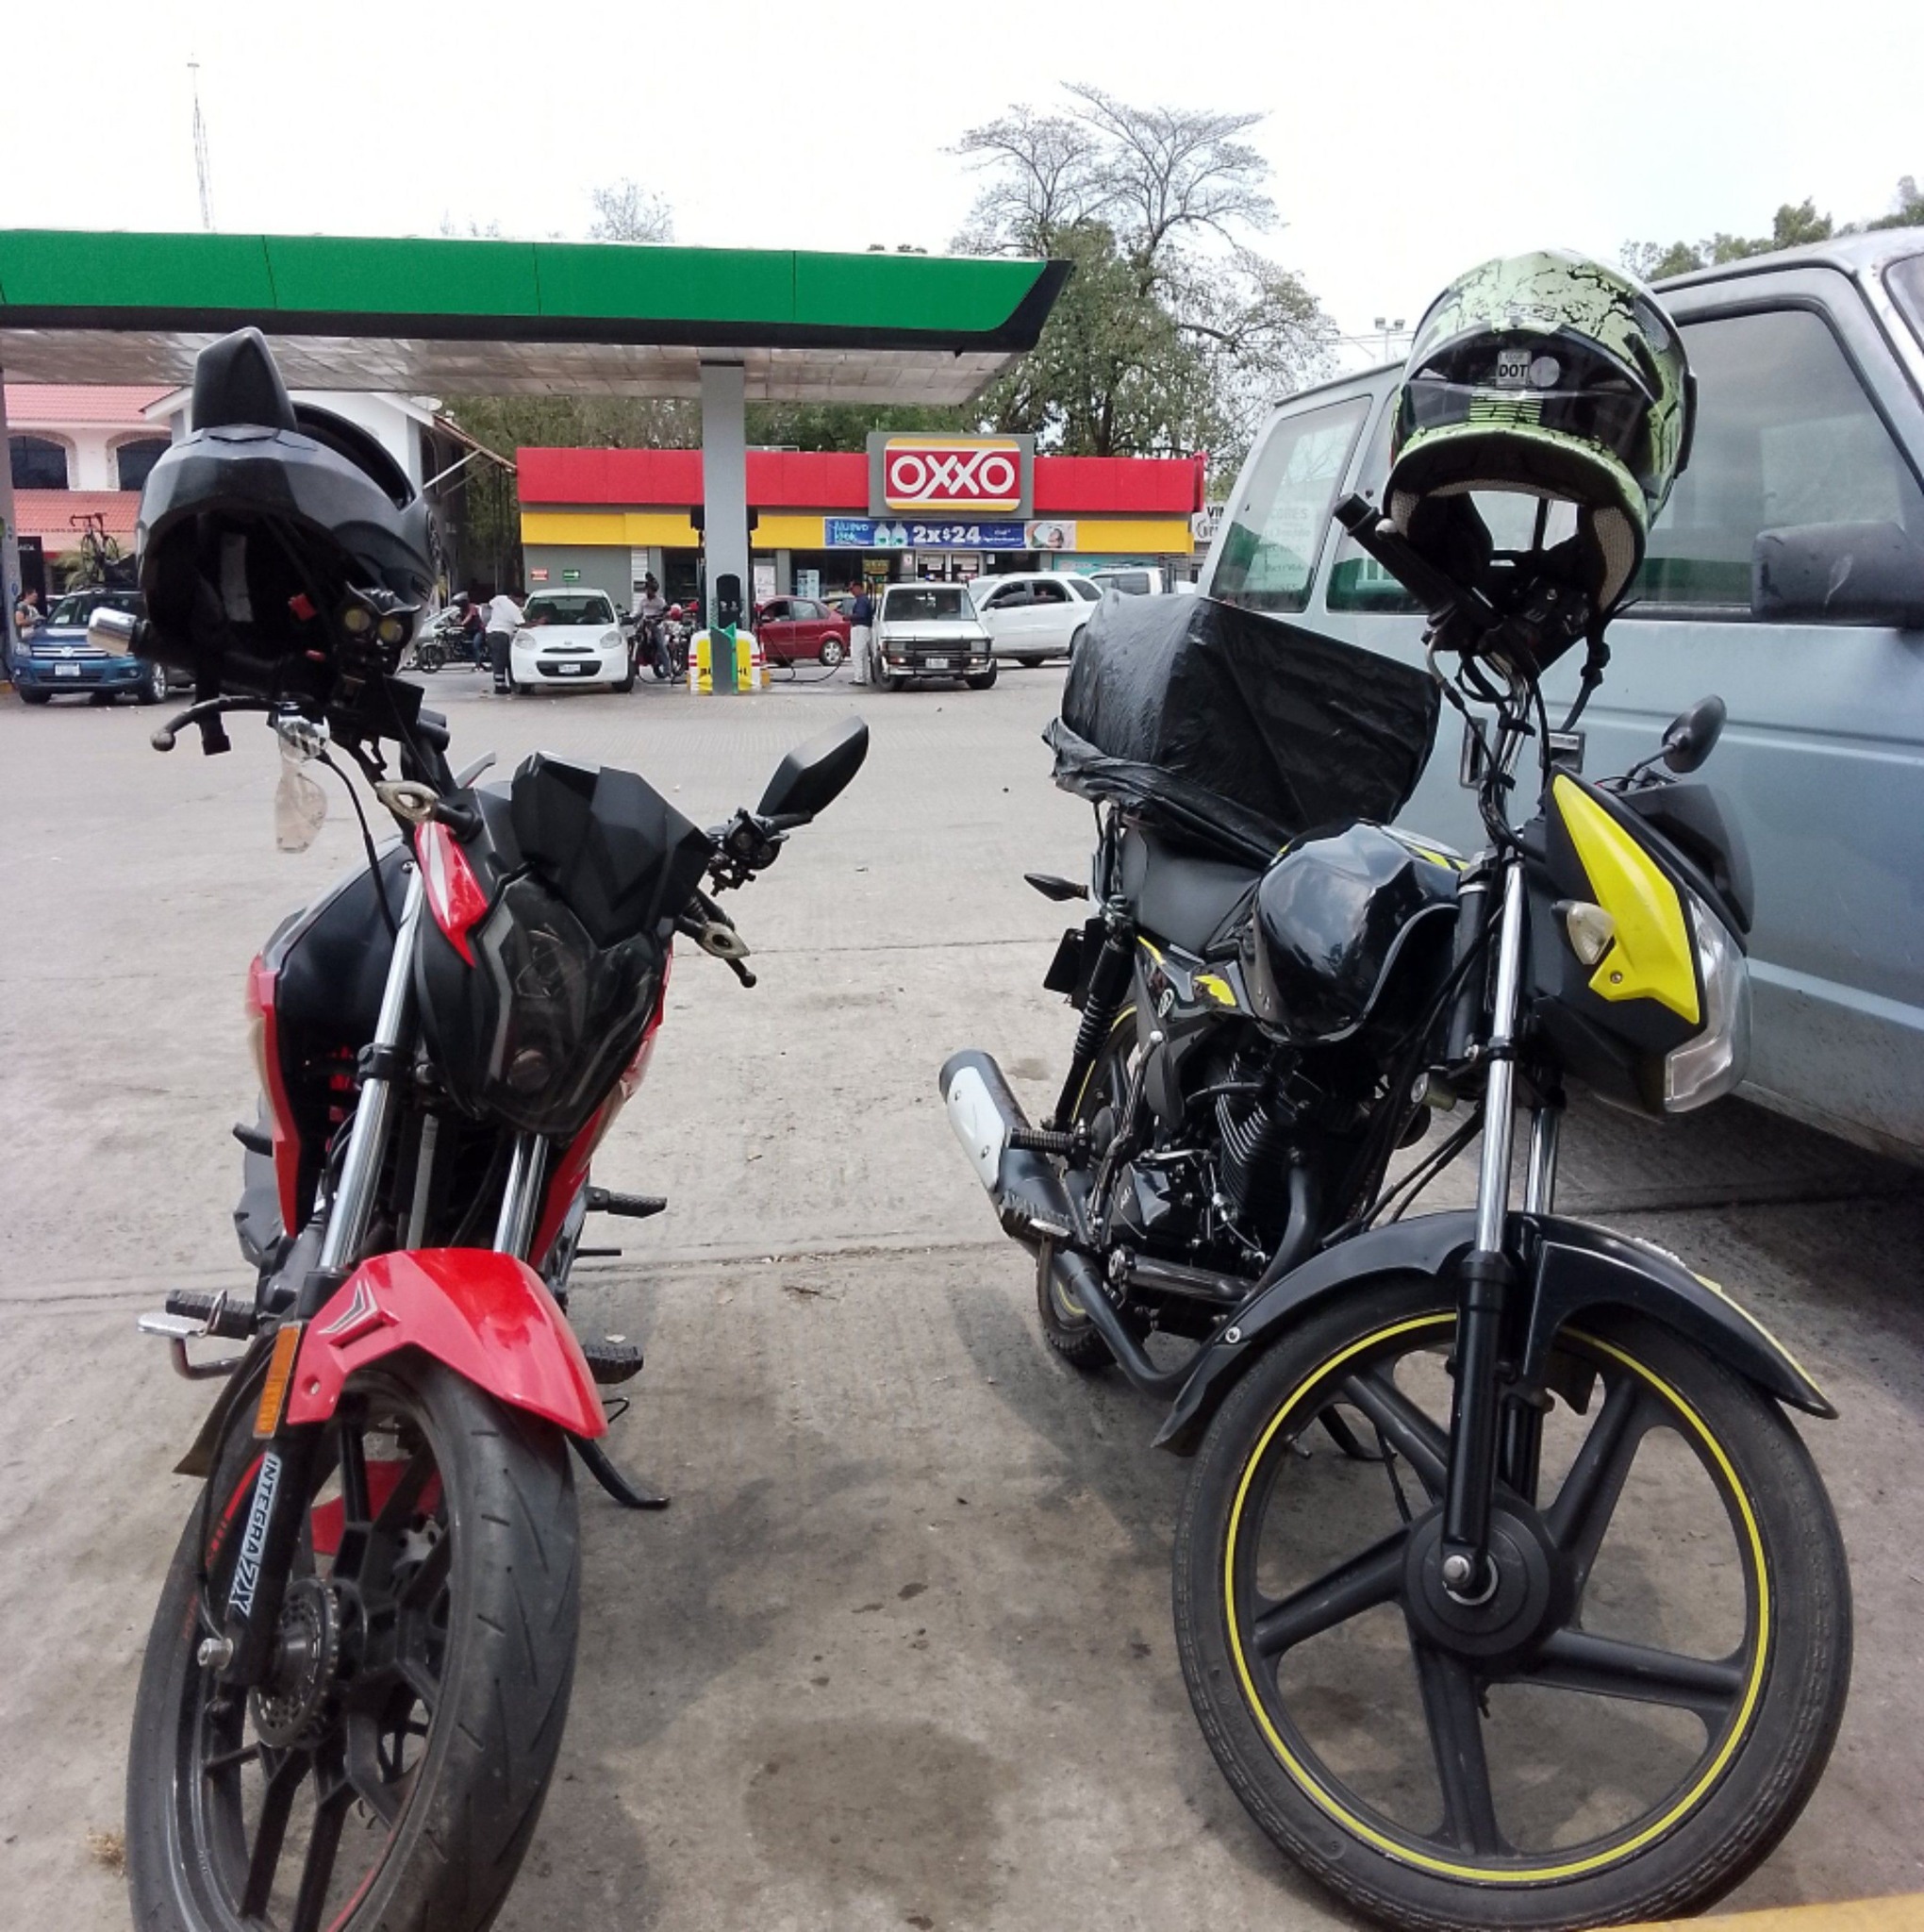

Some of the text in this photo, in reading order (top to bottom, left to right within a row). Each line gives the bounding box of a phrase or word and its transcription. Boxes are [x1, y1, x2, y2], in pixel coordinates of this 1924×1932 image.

[1499, 363, 1529, 378] DOT
[890, 454, 1016, 497] OXXO
[246, 1457, 278, 1555] INTEGRA
